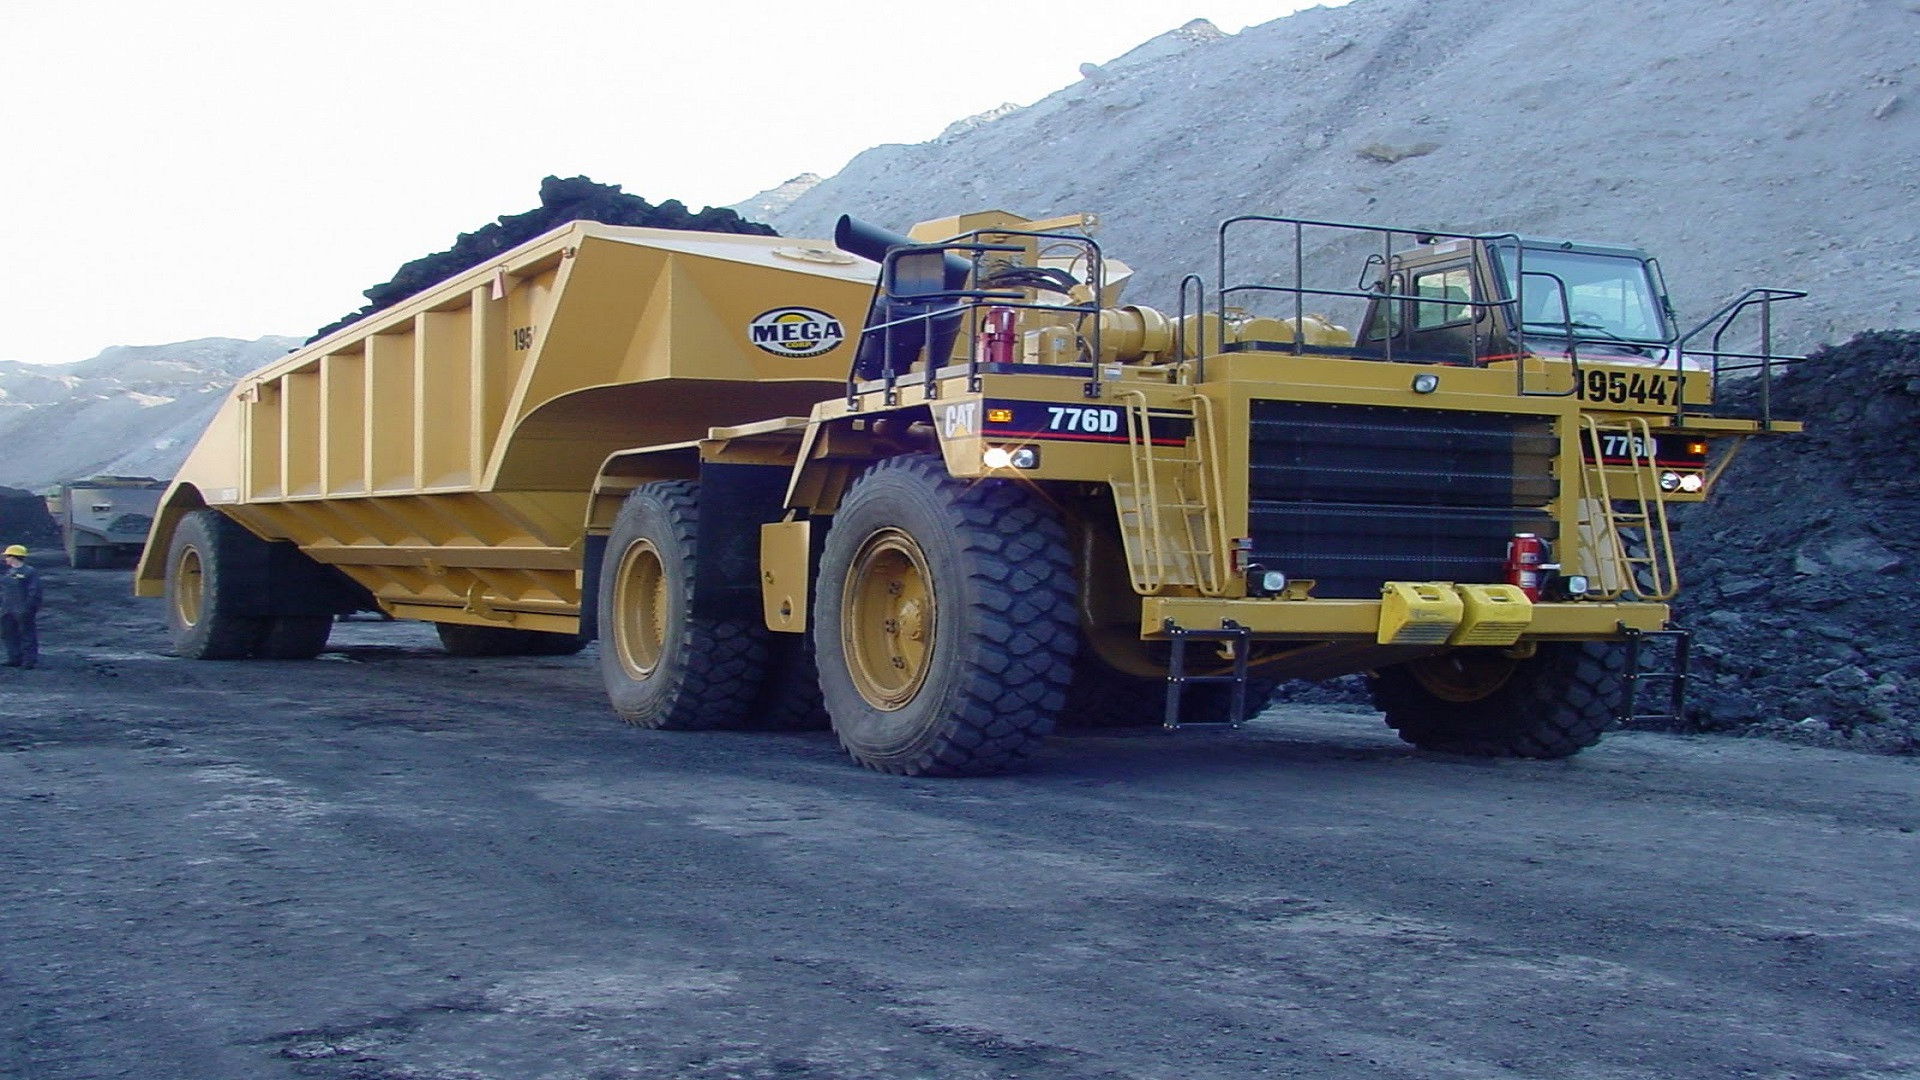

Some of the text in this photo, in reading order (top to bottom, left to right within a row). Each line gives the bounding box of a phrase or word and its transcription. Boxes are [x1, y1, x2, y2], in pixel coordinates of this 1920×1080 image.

[514, 326, 537, 351] 195
[753, 321, 843, 342] MEGA
[1576, 369, 1686, 406] 195447
[945, 403, 976, 438] CAT
[1048, 407, 1118, 432] 776D
